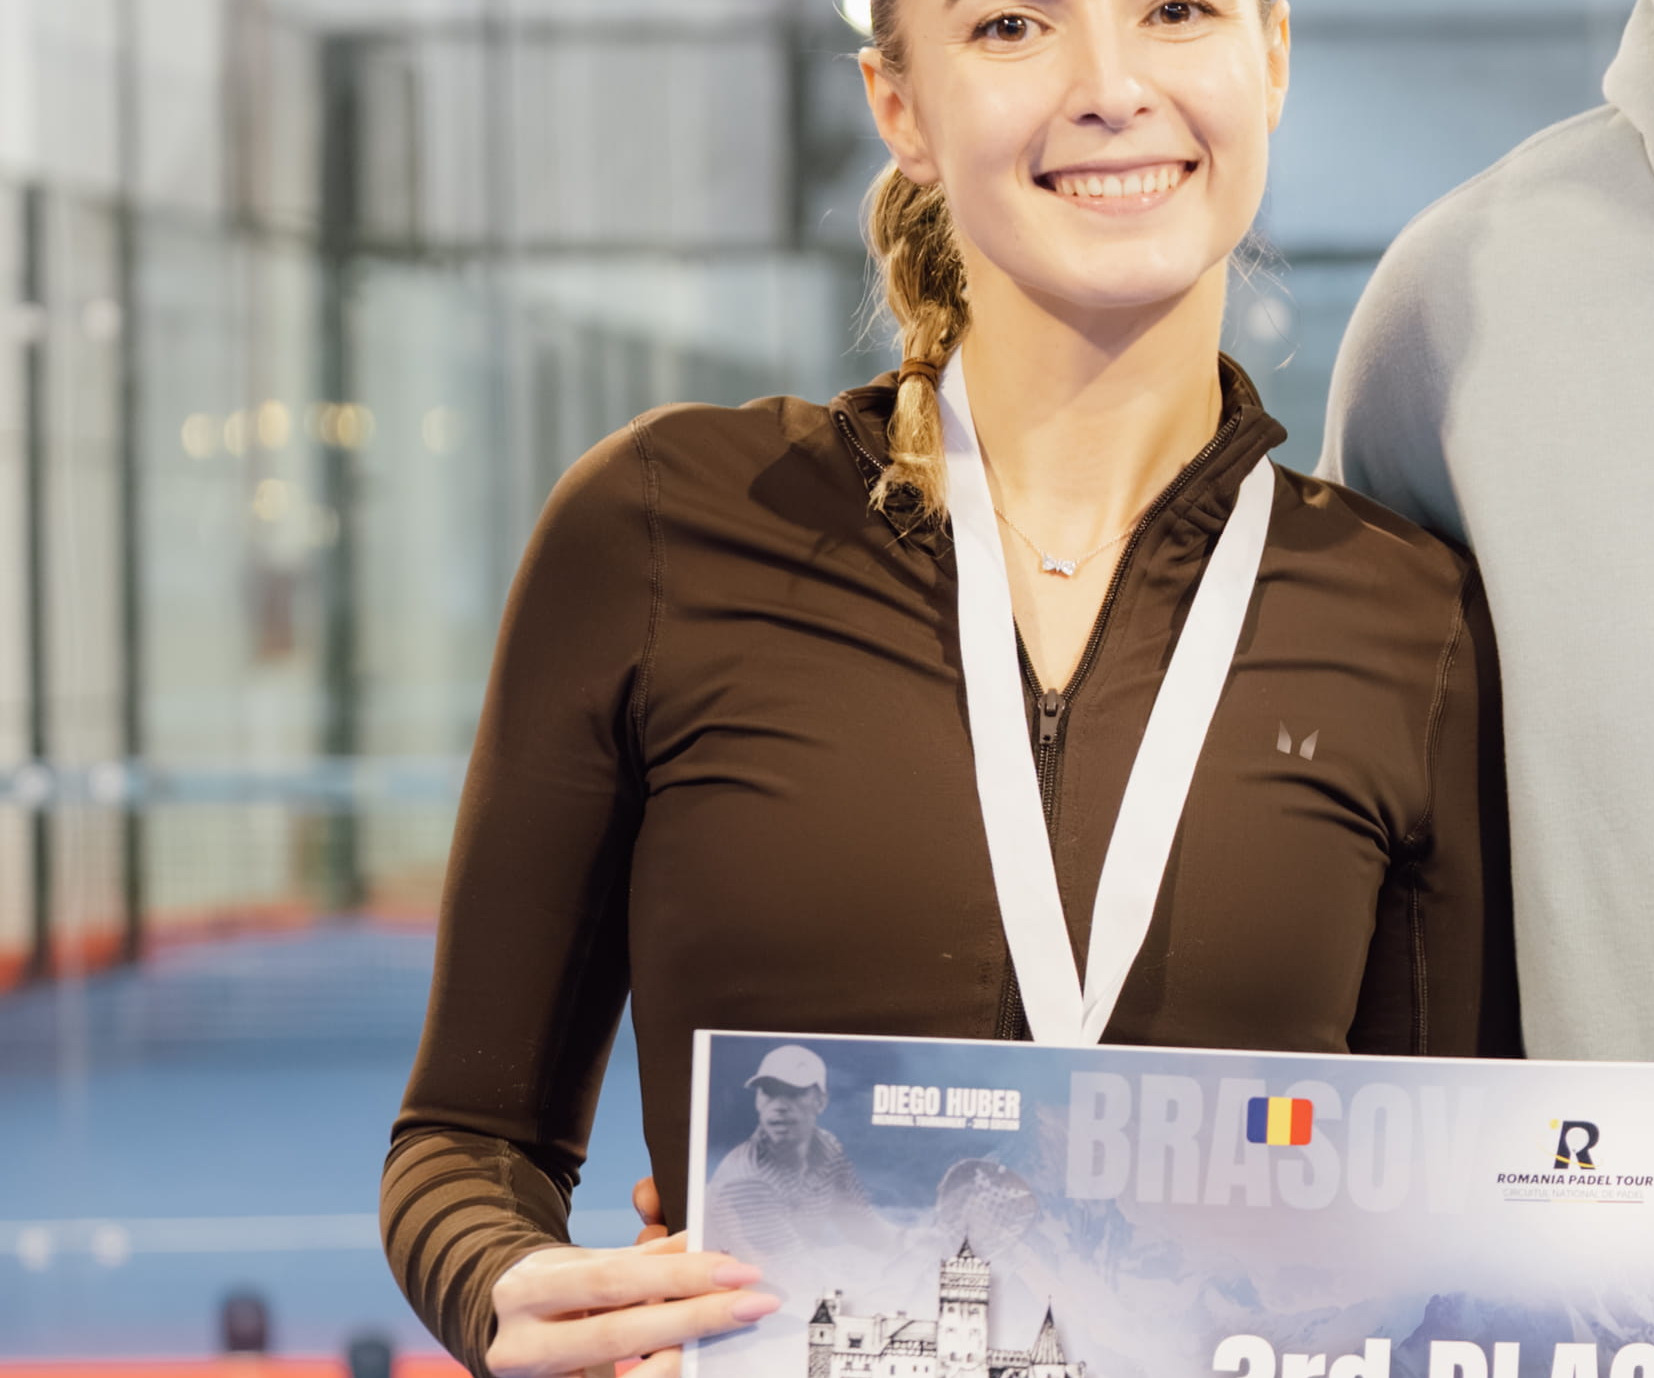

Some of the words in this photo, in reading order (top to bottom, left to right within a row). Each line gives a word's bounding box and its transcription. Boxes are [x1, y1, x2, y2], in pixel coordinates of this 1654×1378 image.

[873, 1084, 941, 1115] DIEGO
[945, 1087, 1021, 1119] HUBER
[1066, 1071, 1487, 1214] BRASOV
[1497, 1173, 1565, 1185] ROMANIA
[1568, 1174, 1612, 1186] PADEL
[1615, 1175, 1654, 1186] TOUR
